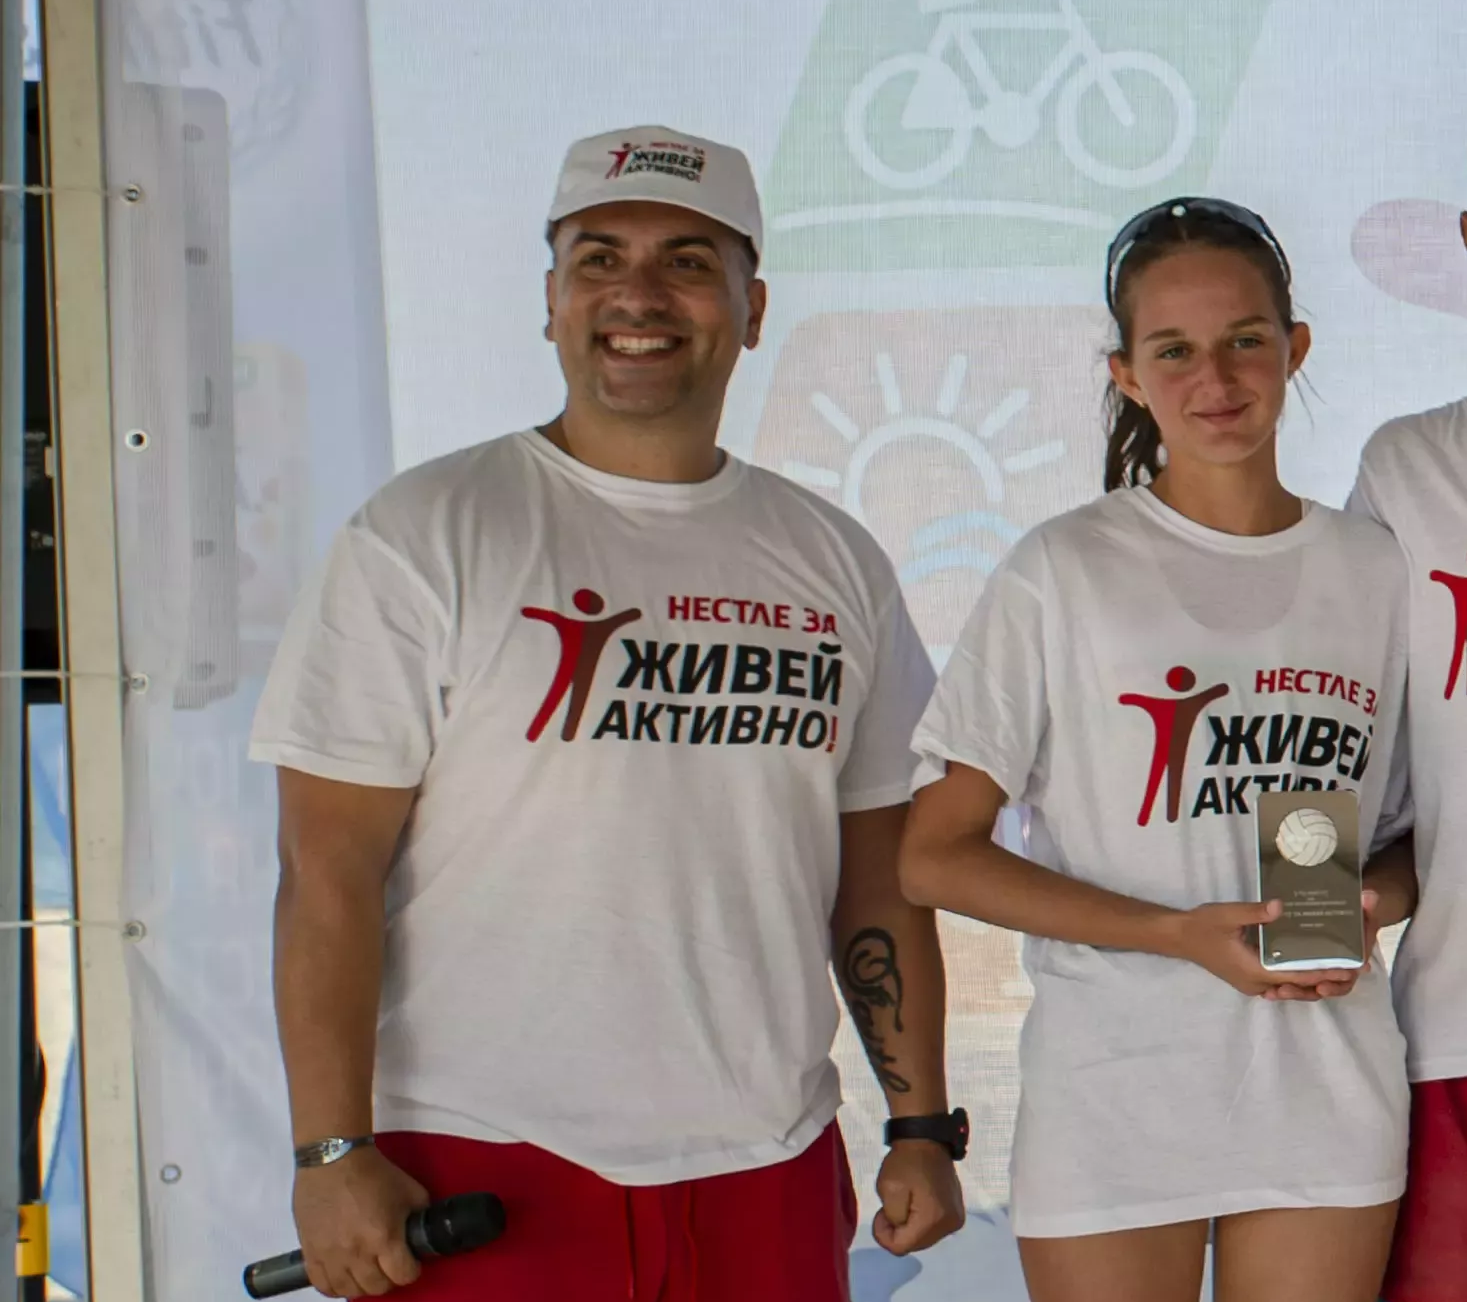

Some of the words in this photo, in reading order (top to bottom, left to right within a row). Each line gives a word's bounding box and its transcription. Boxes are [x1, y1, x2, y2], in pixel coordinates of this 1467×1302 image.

[667, 595, 792, 630] НЕСТЛЕ
[800, 606, 838, 636] ЗА
[615, 637, 845, 707] ЖИВЕЙ
[1254, 666, 1361, 707] НЕСТЛЕ
[1362, 687, 1377, 716] З
[591, 699, 839, 754] АКТИВНО!
